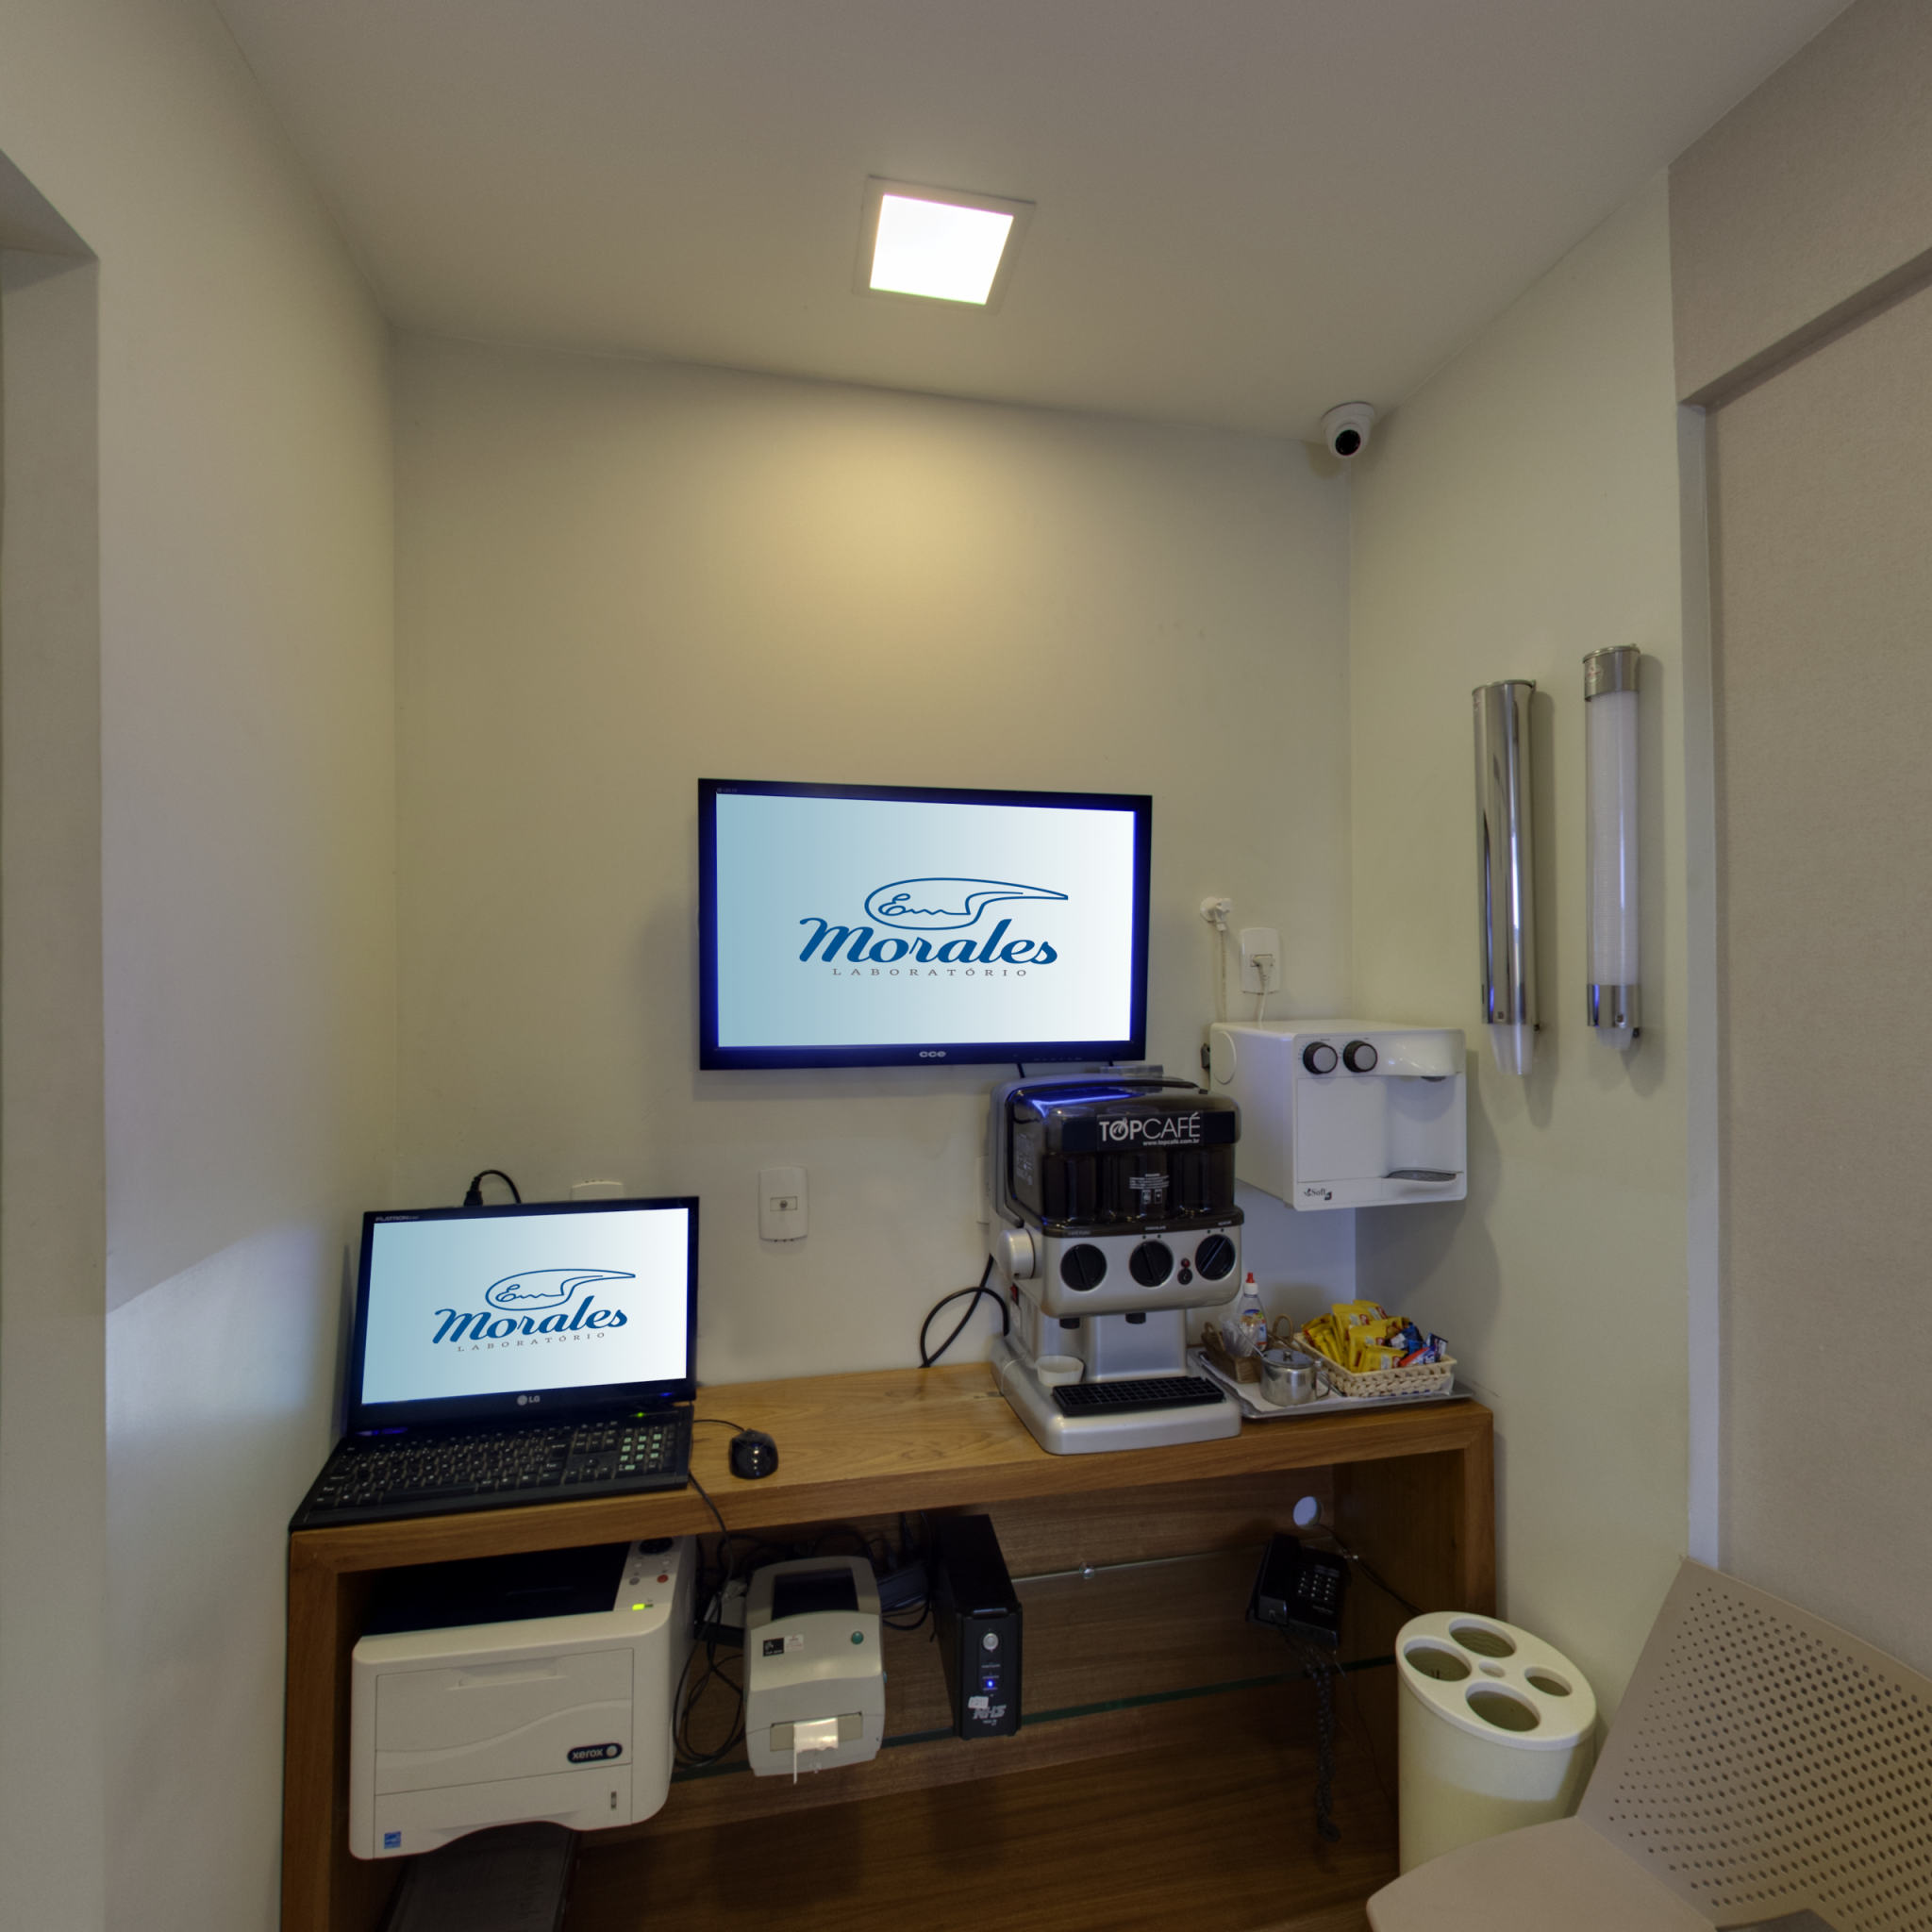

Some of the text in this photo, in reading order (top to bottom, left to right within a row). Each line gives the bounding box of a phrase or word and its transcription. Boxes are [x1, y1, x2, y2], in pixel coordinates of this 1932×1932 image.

[799, 917, 1058, 964] Morales
[832, 967, 1027, 976] LABORATÓRIO
[432, 1295, 627, 1343] Morales
[458, 1332, 605, 1352] LABORATÓRIO
[573, 1748, 604, 1758] xerox
